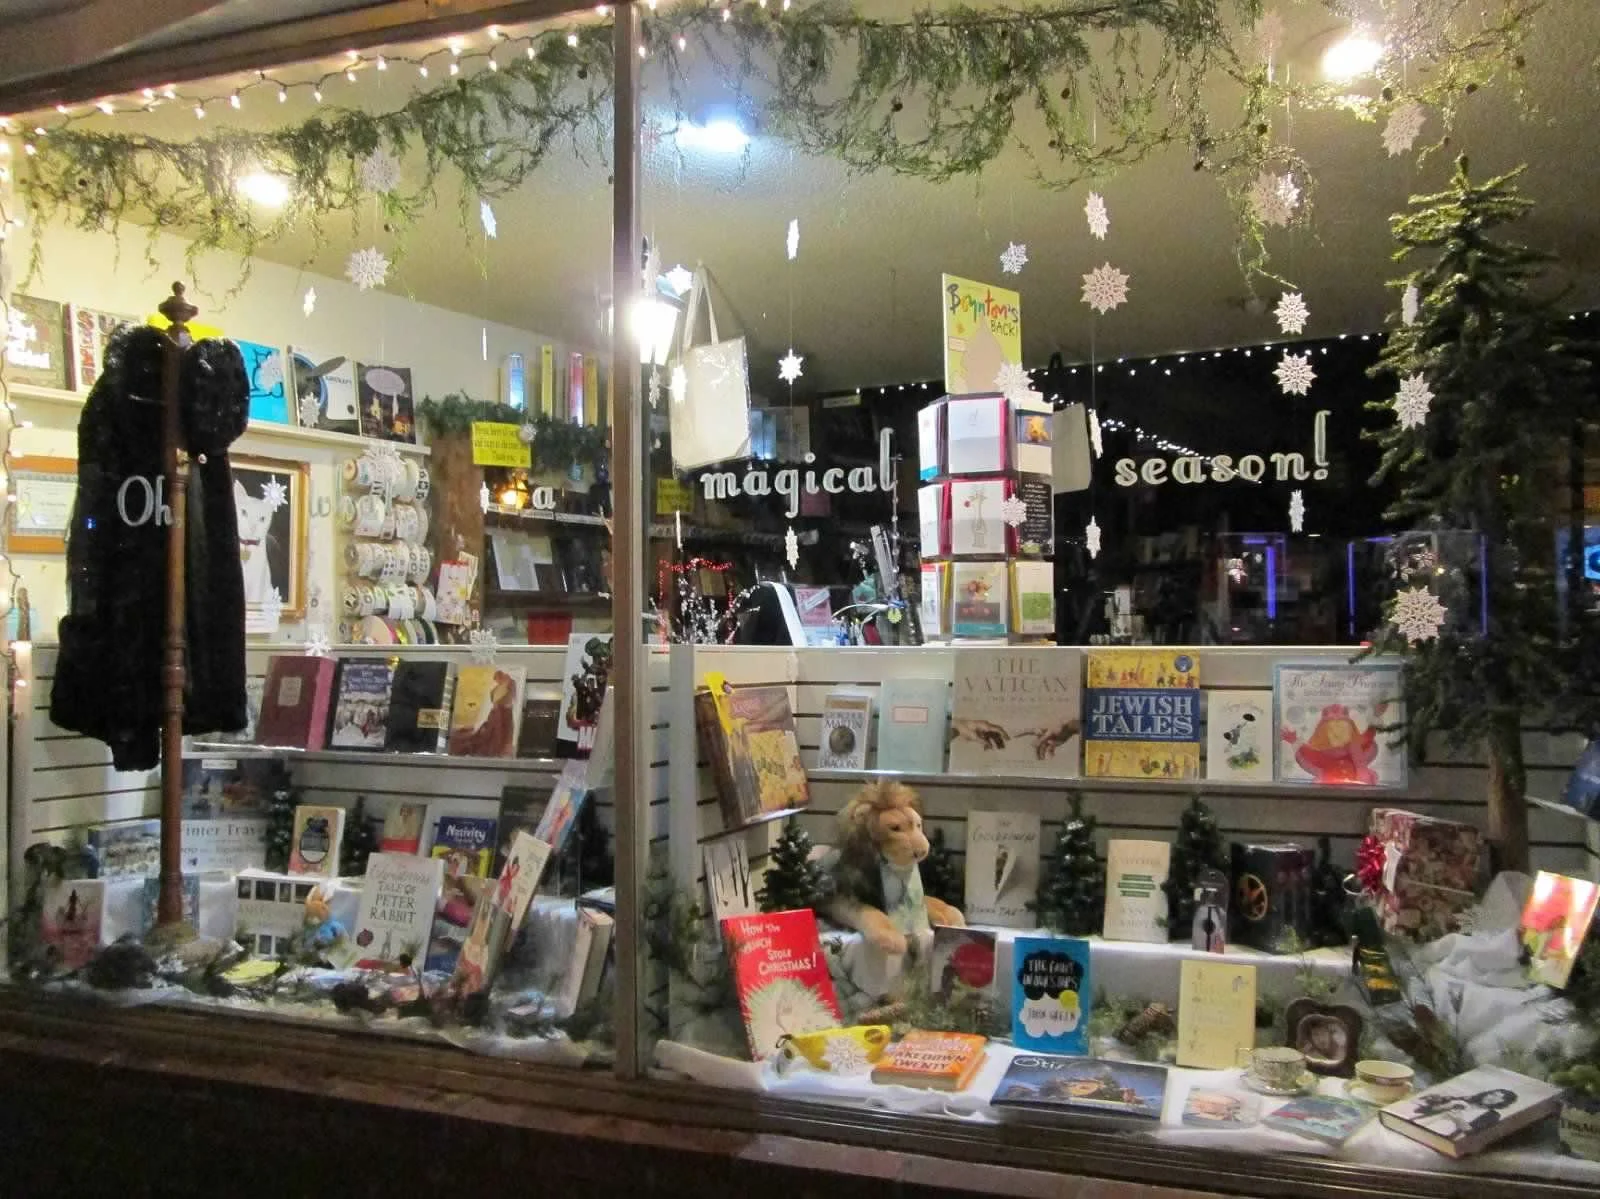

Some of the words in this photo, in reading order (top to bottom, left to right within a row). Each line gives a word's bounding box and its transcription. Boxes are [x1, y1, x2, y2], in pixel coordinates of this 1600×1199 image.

[946, 283, 1019, 324] Boynton's
[990, 319, 1019, 338] BACK!
[532, 486, 557, 510] a
[699, 427, 898, 518] magical
[1114, 409, 1333, 487] season!
[992, 656, 1042, 674] THE
[964, 676, 1073, 693] VATICAN
[1092, 695, 1194, 716] JEWISH
[1092, 714, 1194, 736] TALES
[375, 893, 416, 910] PETER
[369, 905, 417, 924] RABBIT
[739, 919, 764, 937] How
[758, 951, 817, 976] CHRISTMAS!
[767, 949, 793, 960] STOLE
[1028, 959, 1048, 973] THE
[1014, 1056, 1065, 1073] Otis
